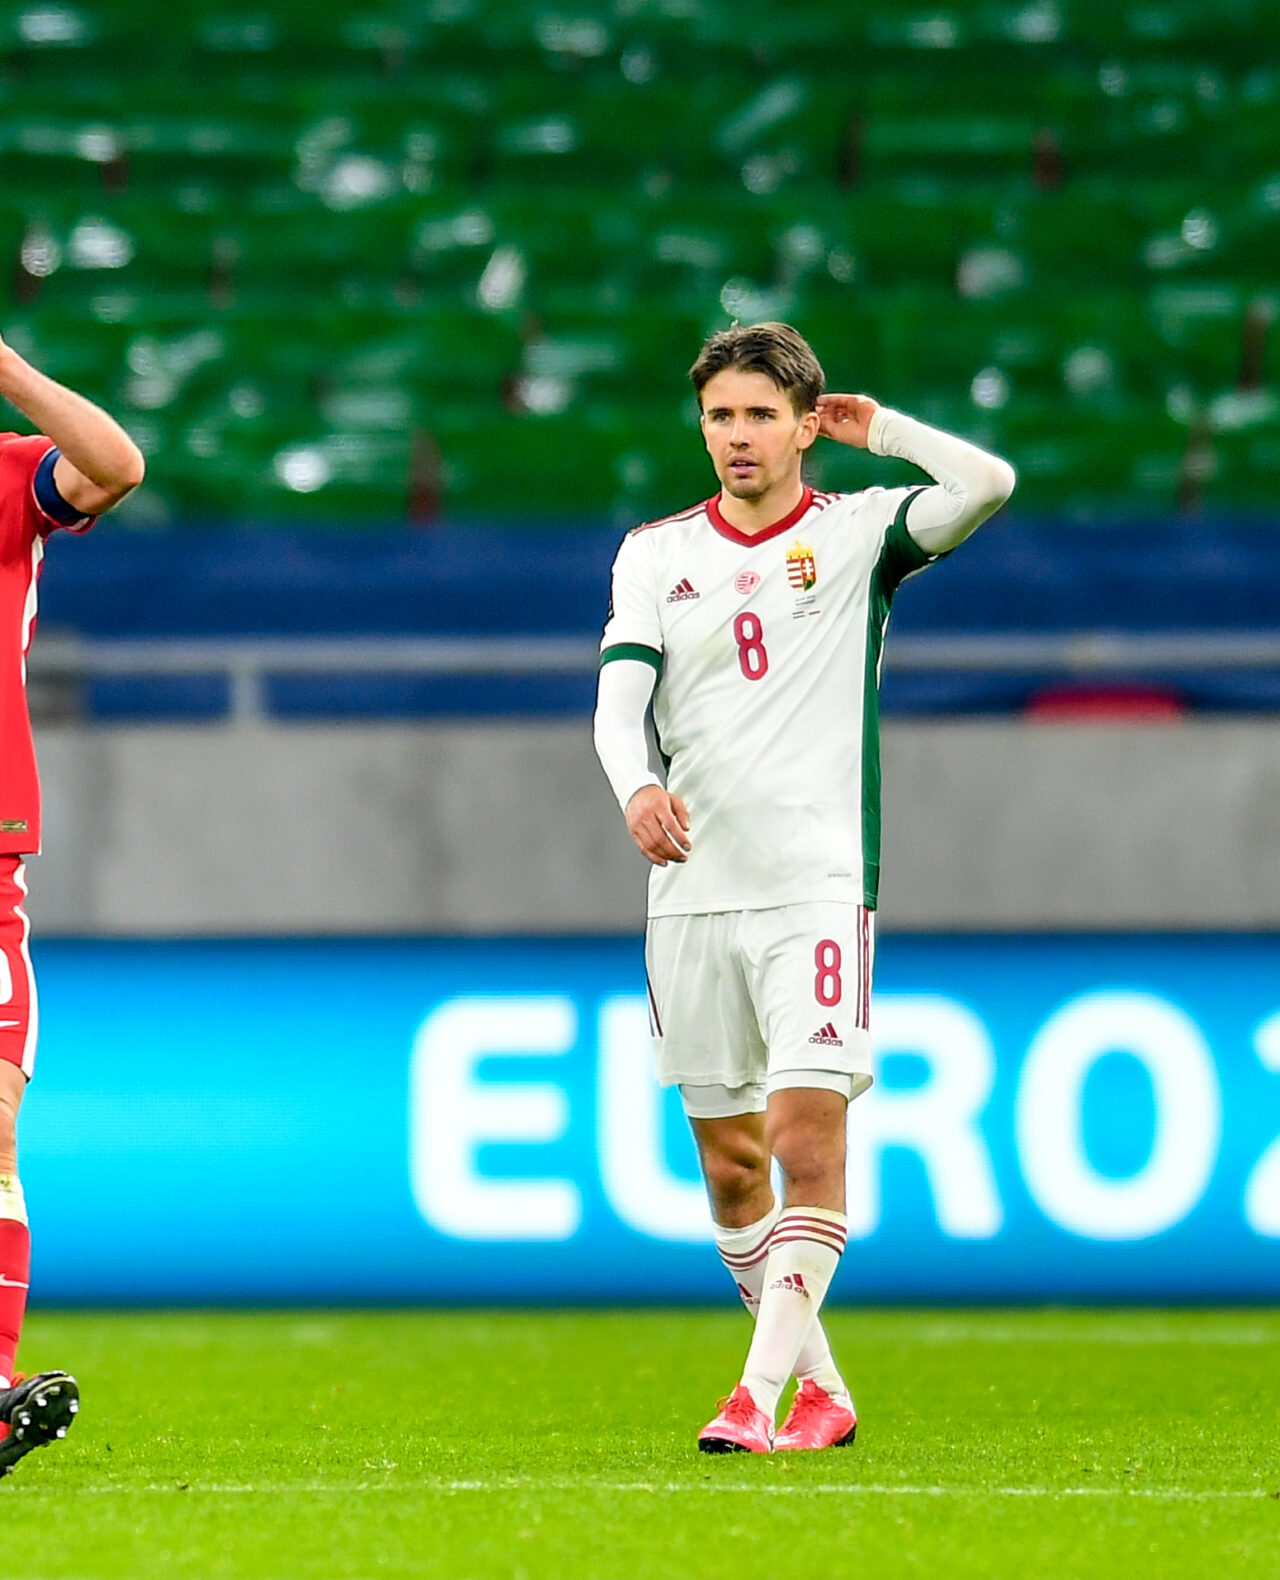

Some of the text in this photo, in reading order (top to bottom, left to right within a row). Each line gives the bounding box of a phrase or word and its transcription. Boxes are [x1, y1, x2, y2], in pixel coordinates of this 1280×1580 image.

[666, 592, 700, 603] adidas
[734, 612, 768, 681] 8
[814, 939, 842, 1007] 8
[808, 1036, 843, 1047] adidas
[407, 992, 1280, 1240] EURO
